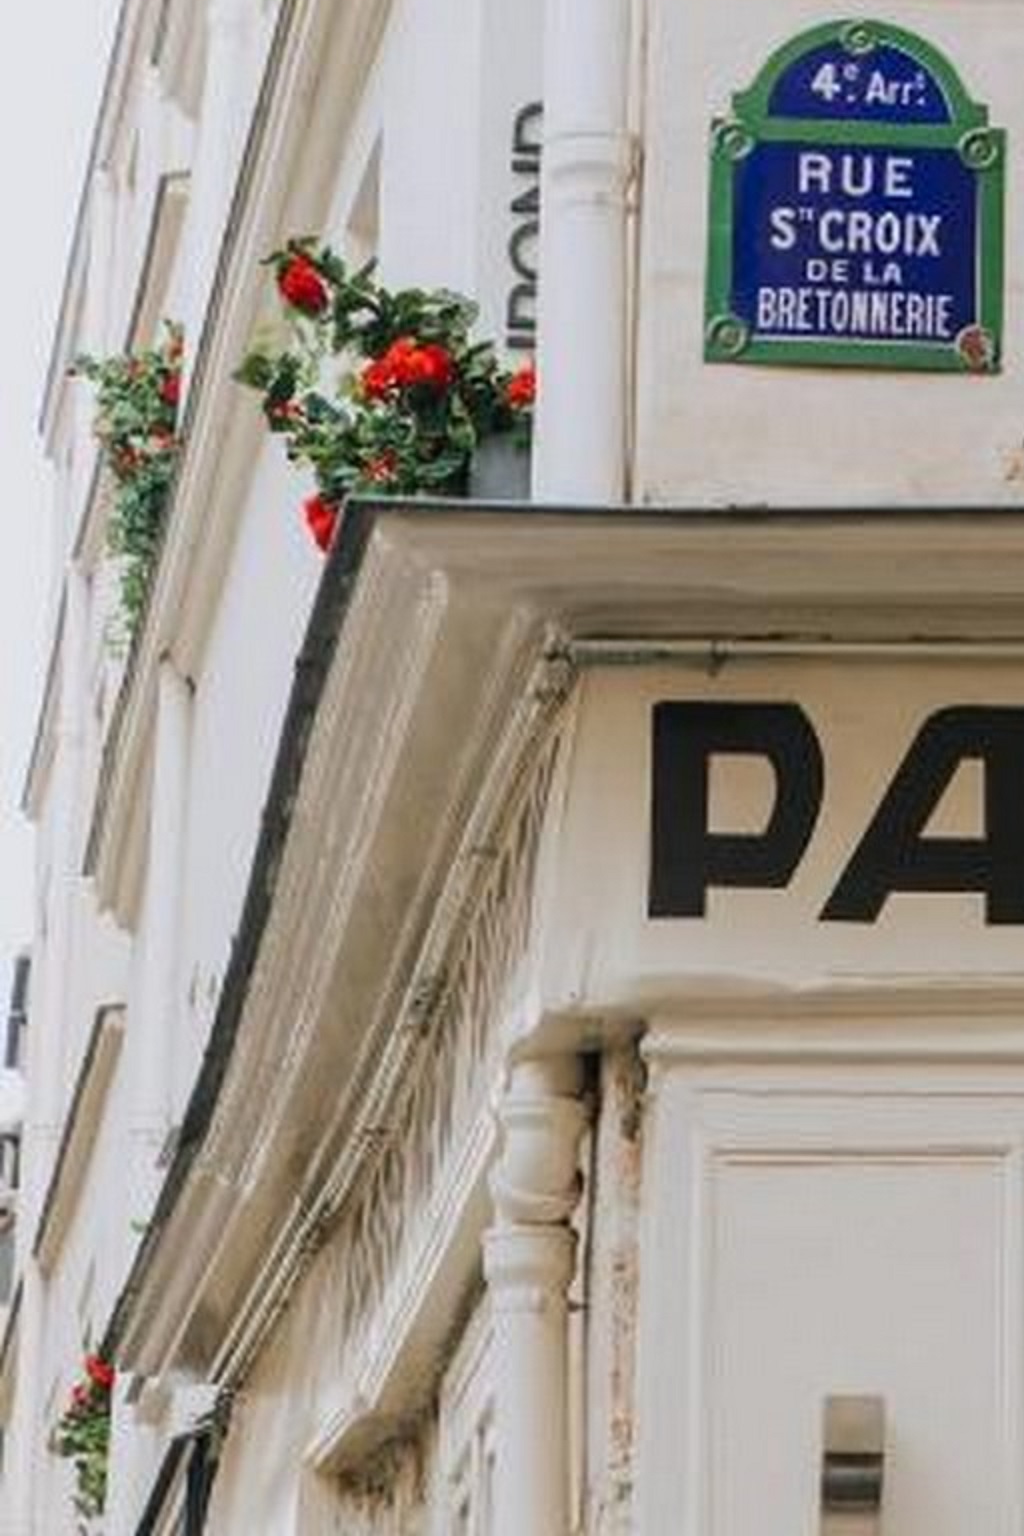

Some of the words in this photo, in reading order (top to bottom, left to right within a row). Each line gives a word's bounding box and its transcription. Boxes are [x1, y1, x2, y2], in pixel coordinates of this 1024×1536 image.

[800, 153, 913, 197] RUE
[819, 211, 941, 256] CROIX
[807, 259, 849, 282] DE
[864, 263, 902, 284] LA
[758, 289, 953, 337] BRETONNERIE
